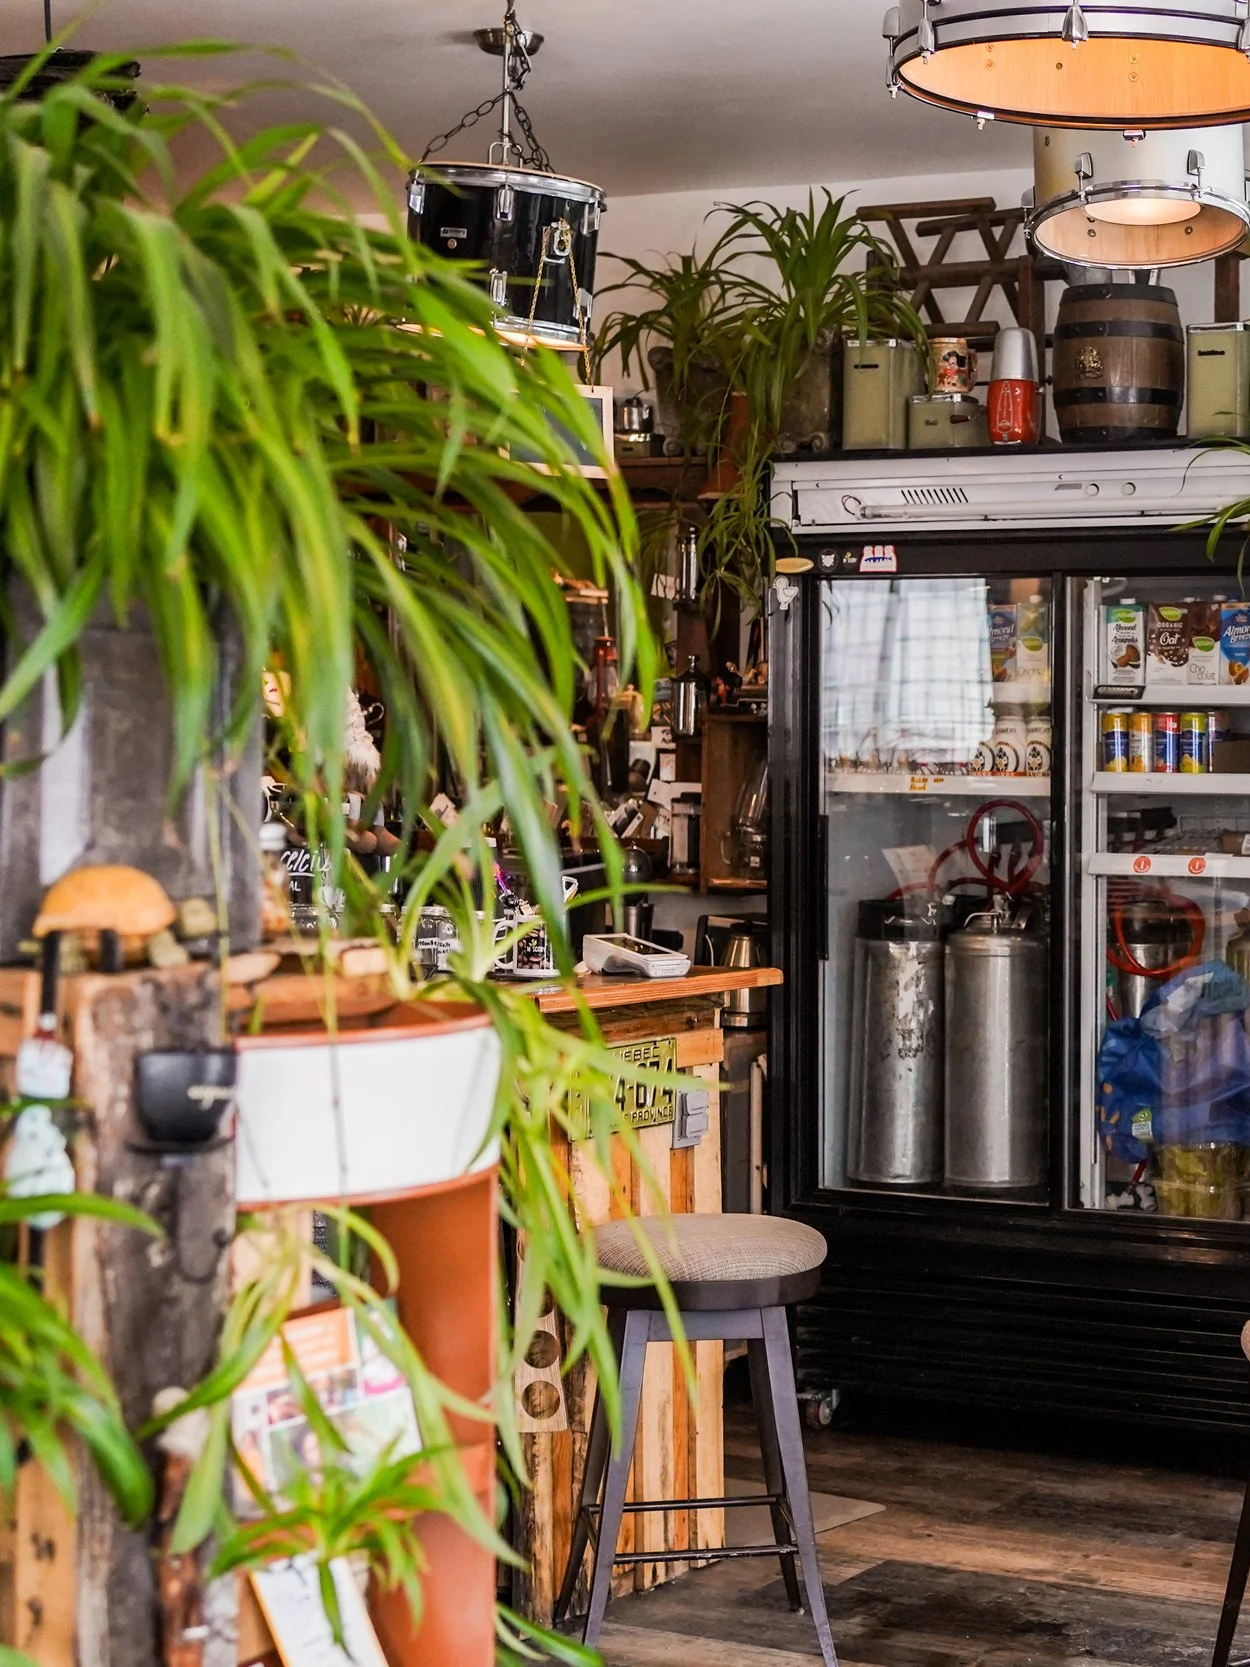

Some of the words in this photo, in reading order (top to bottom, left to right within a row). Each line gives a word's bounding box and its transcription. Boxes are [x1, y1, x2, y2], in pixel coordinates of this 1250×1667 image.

[1160, 632, 1181, 645] Oat
[620, 1045, 661, 1062] ÉBEC
[631, 1104, 674, 1122] PROVINCE
